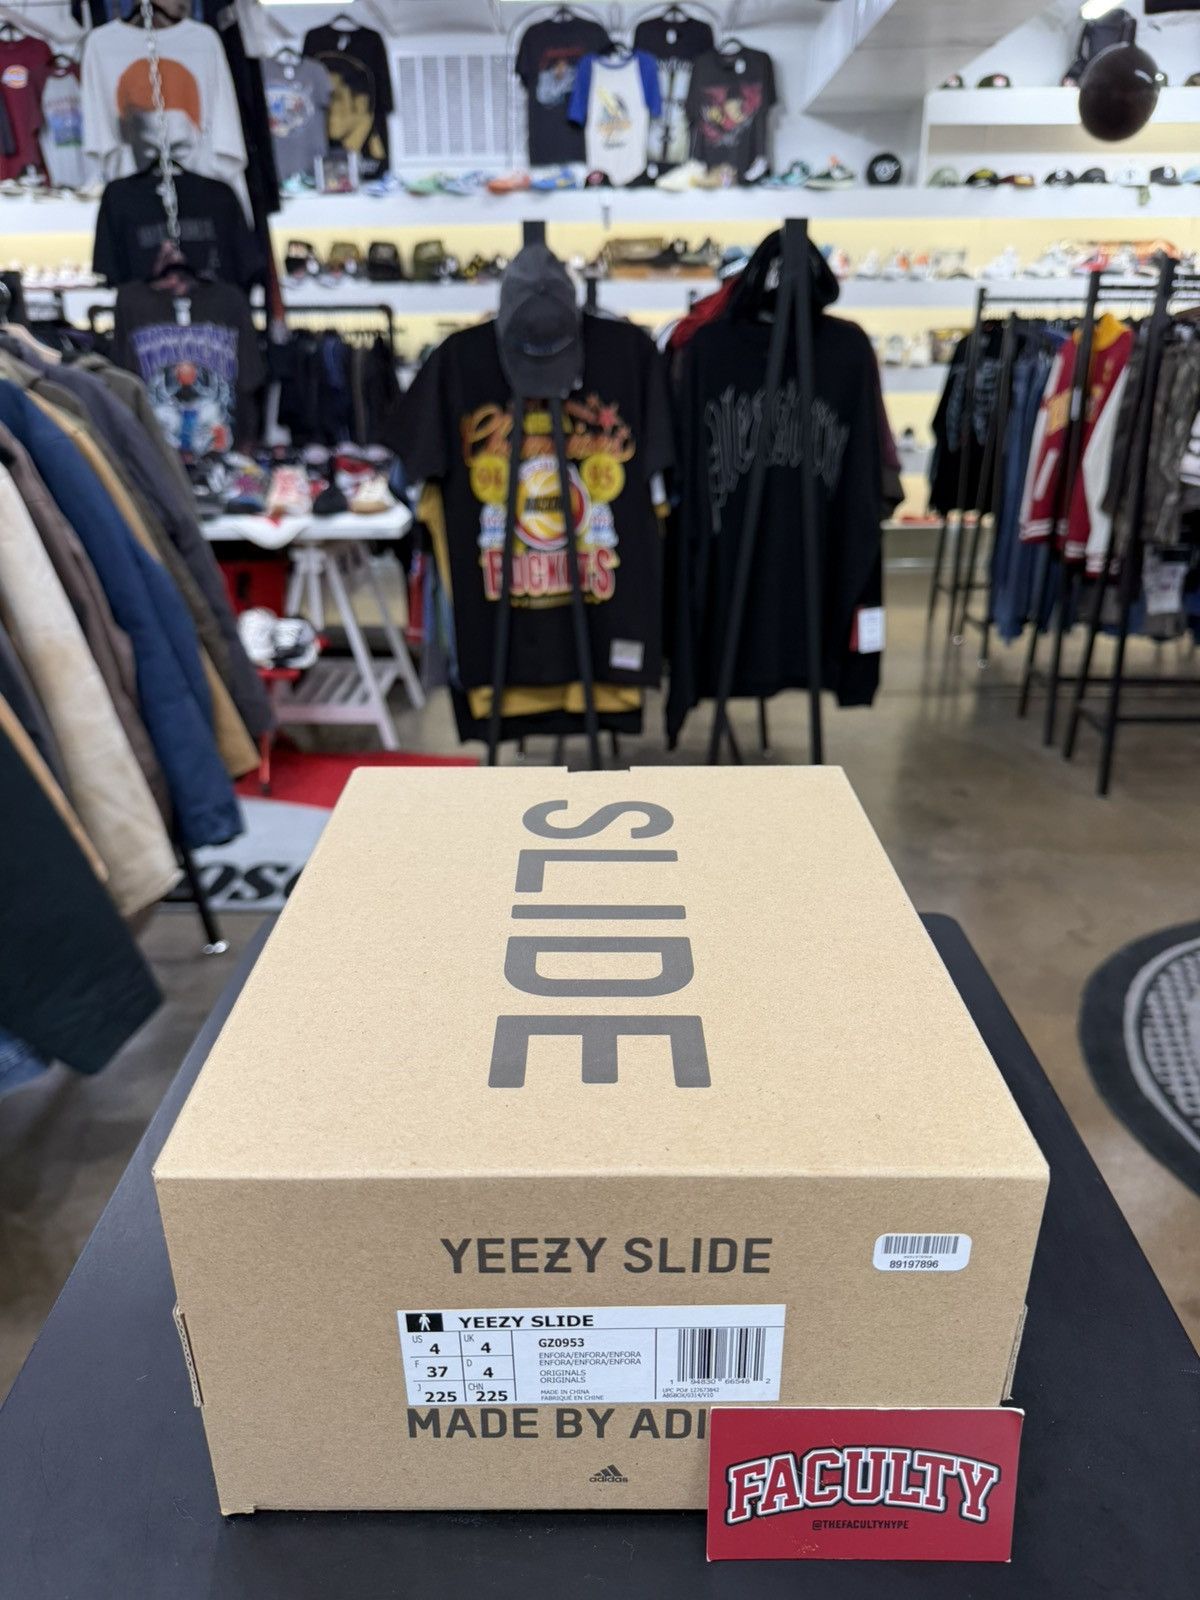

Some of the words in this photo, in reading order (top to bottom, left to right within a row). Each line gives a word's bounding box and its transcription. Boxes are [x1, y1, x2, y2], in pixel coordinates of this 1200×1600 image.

[488, 799, 711, 1088] SLIDE
[440, 1237, 607, 1274] YEEZY
[623, 1237, 773, 1274] SLIDE
[889, 1260, 939, 1269] 89197896
[458, 1316, 525, 1329] YEEZY
[531, 1315, 594, 1327] SLIDE
[412, 1335, 423, 1344] US
[463, 1334, 475, 1343] UK
[538, 1338, 585, 1348] GZ0953
[429, 1343, 440, 1355] 4
[480, 1342, 491, 1353] 4
[539, 1351, 642, 1359] ENFORA/ENFORA/ENFORA
[414, 1360, 420, 1368] F
[466, 1359, 473, 1367] D
[539, 1358, 642, 1366] ENFORA/ENFORA/ENFORA
[426, 1366, 448, 1378] 37
[483, 1367, 494, 1378] 4
[539, 1369, 587, 1377] ORIGINALS
[539, 1376, 587, 1384] ORIGINALS
[468, 1383, 484, 1391] CHN
[425, 1391, 457, 1403] 225
[476, 1390, 508, 1402] 225
[407, 1408, 539, 1439] MADE
[556, 1408, 615, 1439] BY
[629, 1408, 707, 1439] ADI
[589, 1475, 629, 1483] adidas
[725, 1444, 1001, 1526] FACULTY
[812, 1519, 909, 1531] @THEFACULTYHYPE
